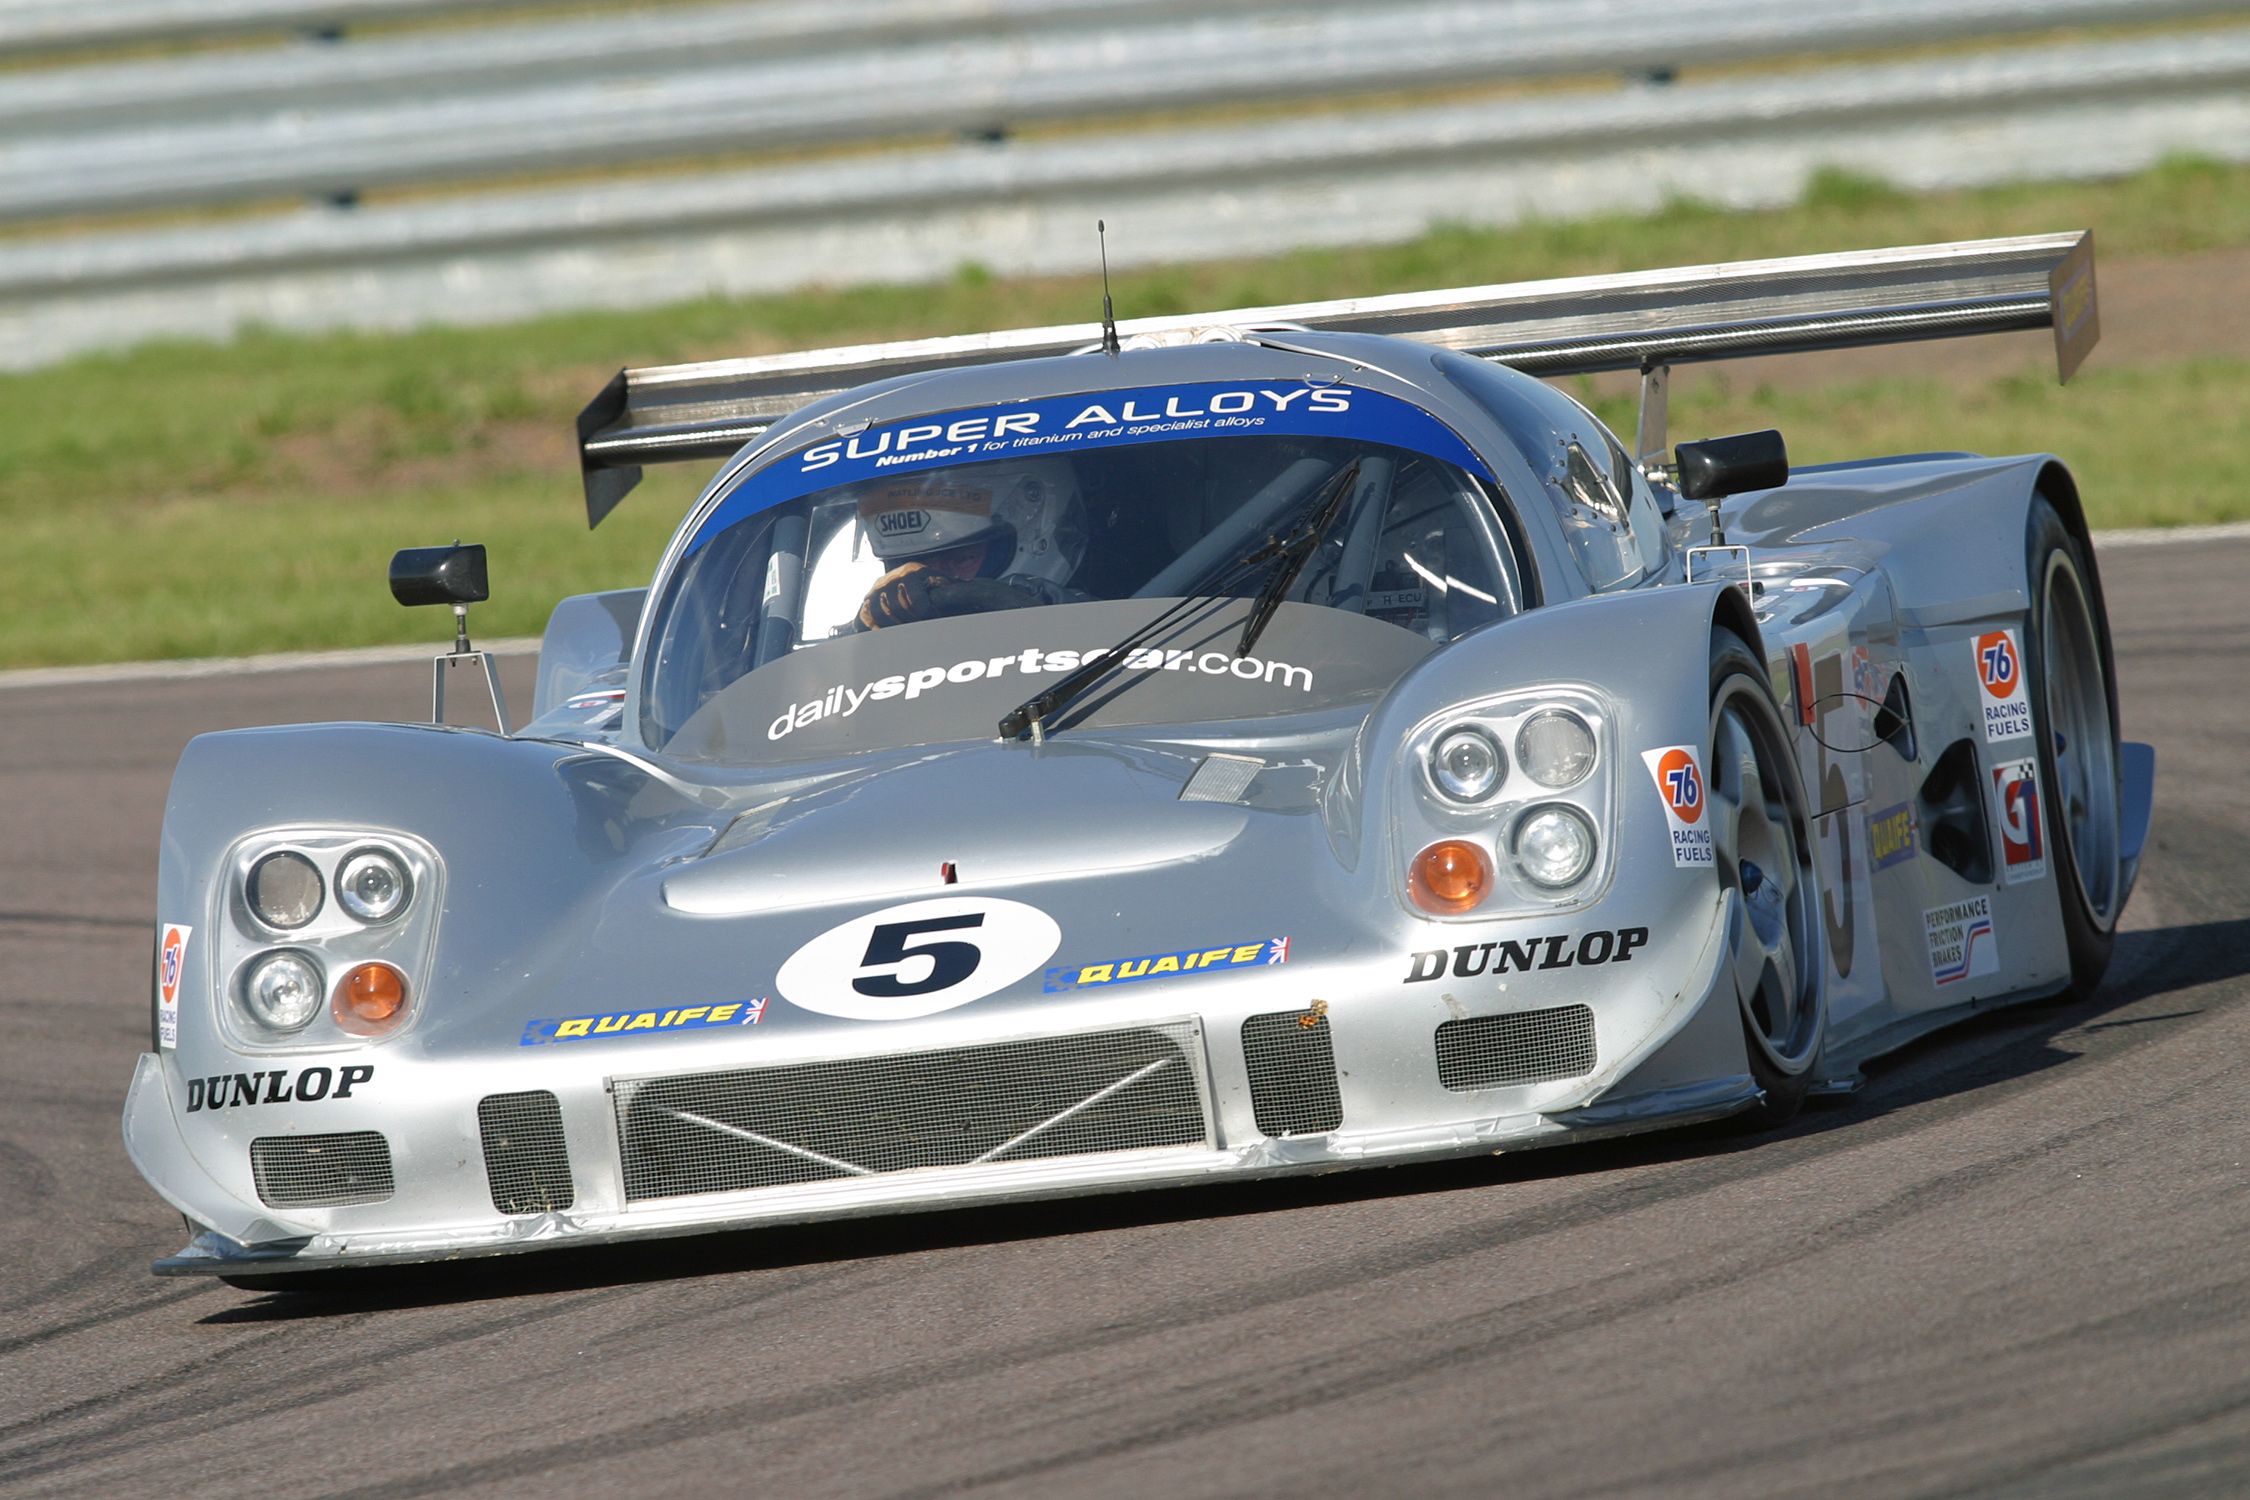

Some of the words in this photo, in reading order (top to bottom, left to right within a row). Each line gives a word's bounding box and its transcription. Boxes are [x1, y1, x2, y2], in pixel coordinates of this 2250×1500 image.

[801, 412, 1041, 473] SUPER
[1065, 388, 1353, 429] ALLOYS
[875, 447, 964, 468] Number
[966, 443, 978, 453] 1
[982, 439, 1010, 452] for
[1012, 430, 1083, 448] titanium
[1087, 425, 1123, 440] and
[1127, 417, 1211, 436] specialist
[1214, 415, 1266, 428] alloys
[880, 510, 922, 532] SHOEI
[1982, 639, 2013, 686] 76
[1985, 701, 2027, 721] RACING
[1988, 718, 2030, 738] FUELS
[1665, 763, 1701, 808] 76
[1672, 829, 1711, 845] RACING
[1676, 847, 1713, 863] FUELS
[1925, 898, 1988, 930] PERFORMANCE
[1929, 923, 1965, 948] FRICTION
[161, 943, 181, 987] 76
[851, 912, 986, 998] 5
[1076, 943, 1266, 985] QUAIFE
[1402, 926, 1650, 984] DUNLOP
[1932, 945, 1963, 968] BRAKES
[553, 1002, 743, 1037] QUAIFE
[186, 1064, 375, 1113] DUNLOP
